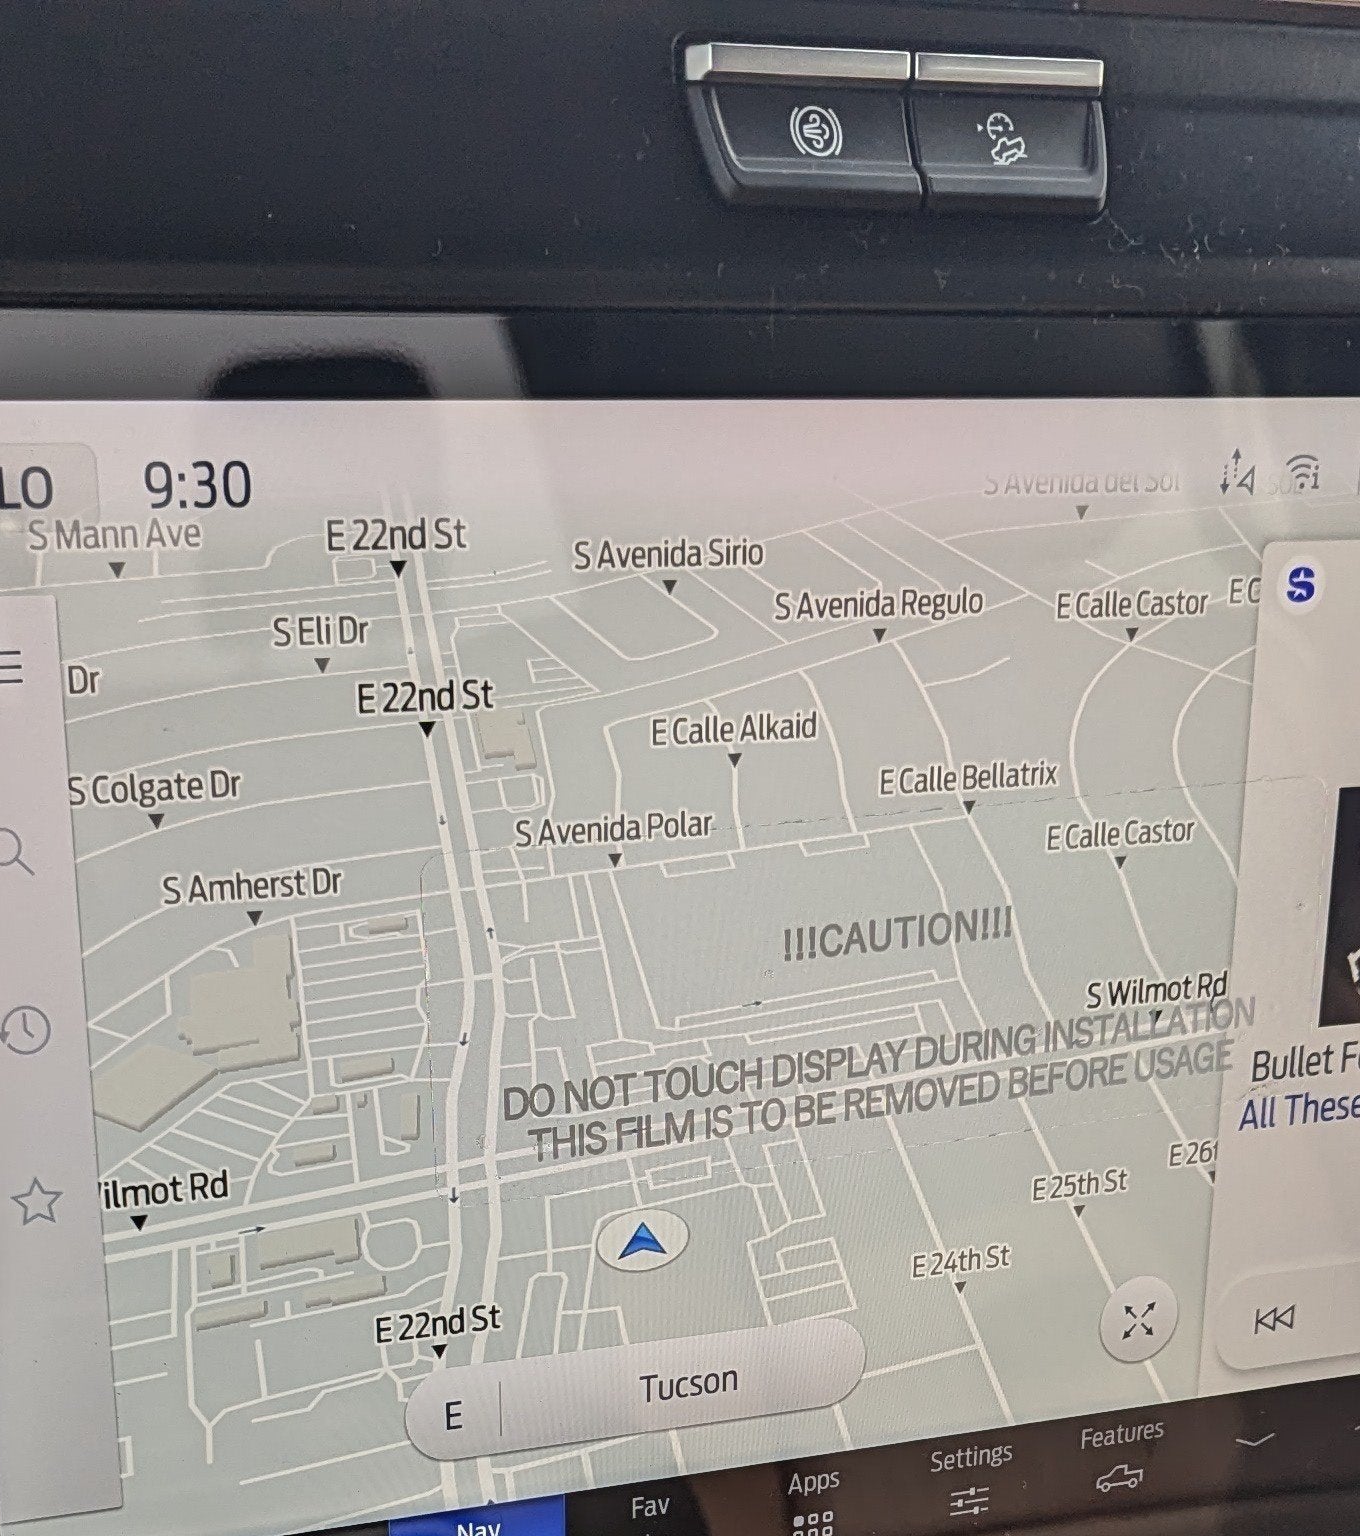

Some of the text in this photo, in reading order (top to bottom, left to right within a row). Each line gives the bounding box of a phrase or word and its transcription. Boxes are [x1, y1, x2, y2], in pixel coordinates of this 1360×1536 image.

[144, 460, 252, 509] 9:30
[28, 520, 201, 551] S Mann Ave
[327, 517, 467, 550] E 22nd St
[574, 538, 764, 569] S Avenida Sirio
[775, 586, 983, 622] S Avenida Regulo
[1056, 588, 1209, 620] E Calle Castor
[1229, 578, 1243, 604] E
[273, 616, 369, 647] S Eli Dr
[68, 665, 100, 694] Dr
[358, 679, 494, 713] E 22nd St
[652, 711, 818, 747] E Calle Alkaid
[68, 769, 241, 808] S Colgate Dr
[880, 760, 1058, 796] E Calle Bellatrix
[516, 811, 713, 848] S Avenida Polar
[1047, 818, 1196, 851] E Calle Castor
[163, 868, 342, 906] S Amherst Dr
[783, 907, 1013, 961] !!!CAUTION!!!
[1086, 971, 1228, 1009] S Wilmot Rd
[505, 996, 1256, 1121] DO NOT TOUCH DISPLAY DURING INSTALLATION
[1252, 1046, 1333, 1082] Bullet
[528, 1039, 1235, 1163] THIS FILM IS TO BE REMOVED BEFORE USAGE
[1238, 1096, 1275, 1131] All
[1170, 1144, 1182, 1166] E
[98, 1169, 228, 1209] ilmot Rd
[1032, 1169, 1128, 1200] E 25th St
[913, 1243, 1010, 1279] E 24th St
[376, 1305, 501, 1343] E 22nd St
[640, 1366, 738, 1404] Tucson
[446, 1402, 463, 1430] E
[1081, 1419, 1164, 1450] Features
[930, 1441, 1013, 1475] Settings
[788, 1468, 840, 1499] Apps
[631, 1494, 670, 1520] Fav
